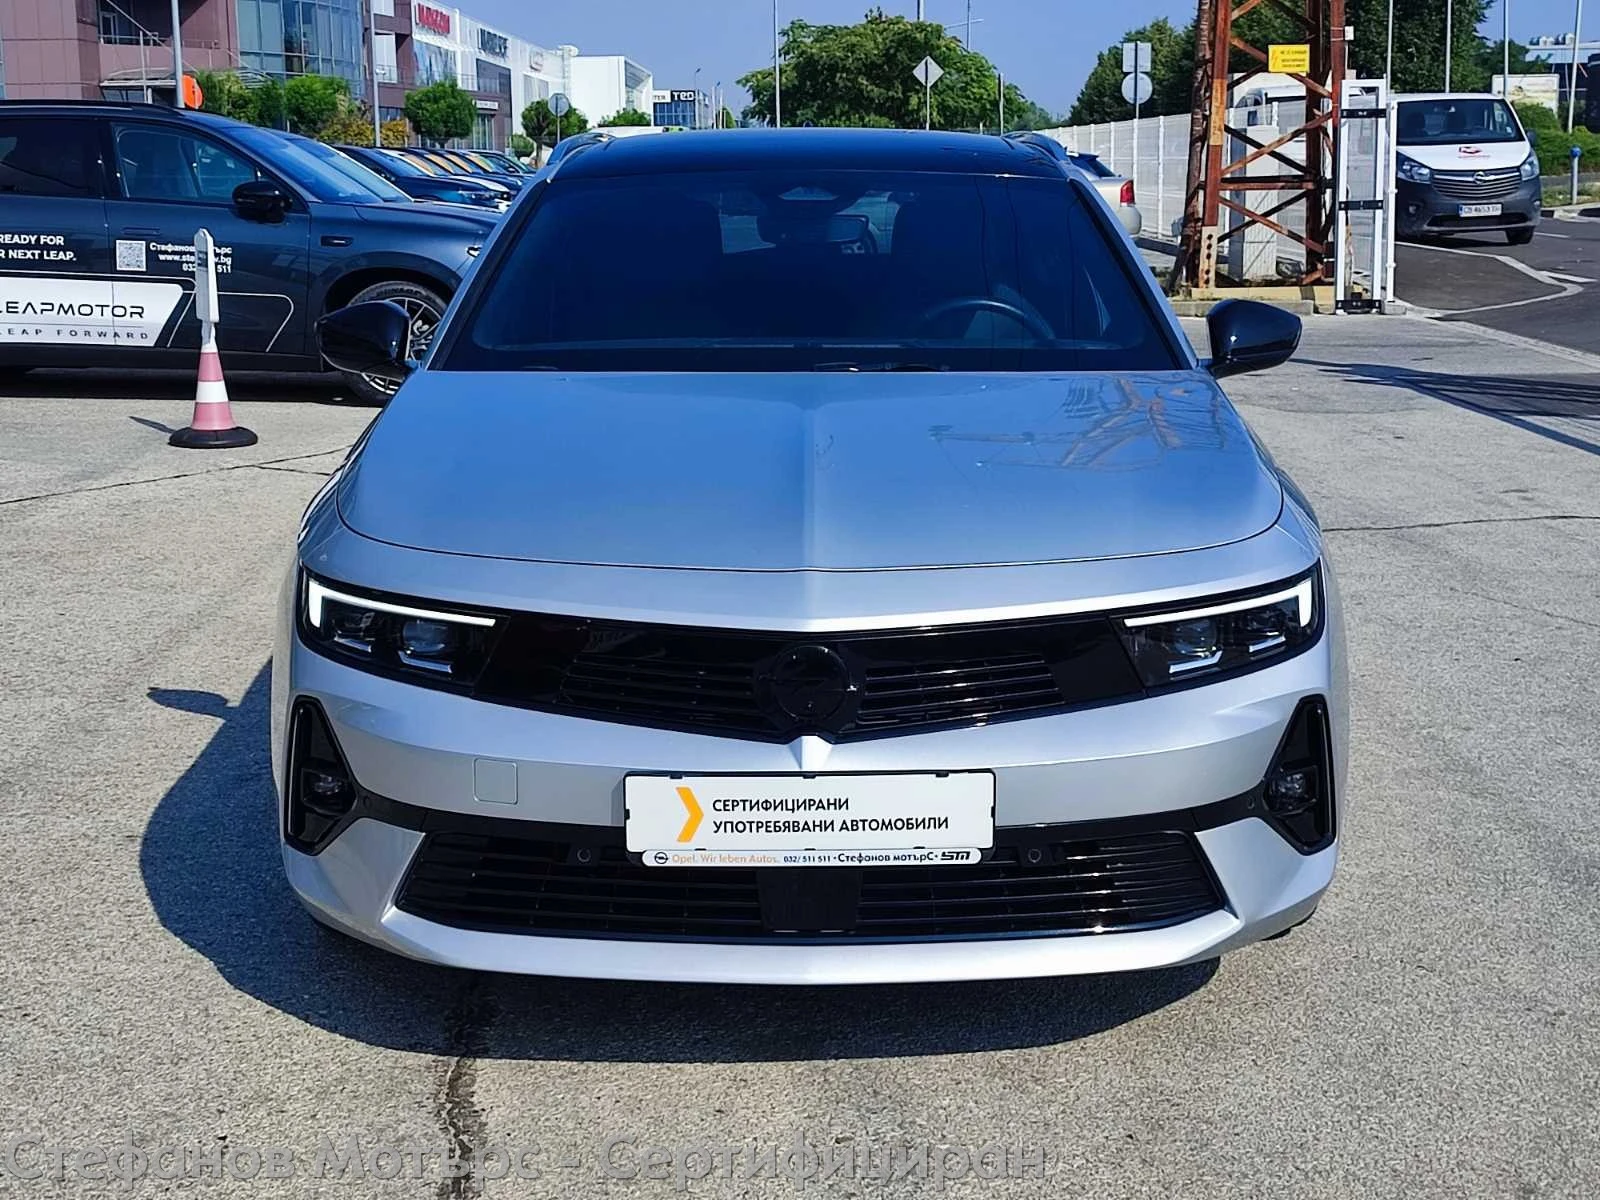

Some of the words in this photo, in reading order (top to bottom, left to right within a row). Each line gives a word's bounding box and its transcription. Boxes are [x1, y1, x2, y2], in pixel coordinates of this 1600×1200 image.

[40, 235, 65, 246] FOR
[8, 249, 41, 259] NEXT
[43, 250, 77, 261] LEAP.
[217, 264, 231, 273] 511
[0, 300, 145, 319] EAPMOTOR
[0, 328, 42, 336] EAP
[57, 329, 148, 340] FORWARD
[712, 798, 849, 814] СЕРТИФИЦИРАНИ
[713, 820, 835, 834] УПОТРЕБЯВАНИ
[839, 816, 950, 832] АВТОМОБИЛИ
[700, 853, 717, 863] Wir
[719, 853, 747, 863] leben
[802, 855, 816, 863] 511
[818, 855, 831, 863] 511
[838, 852, 890, 864] Стефанов
